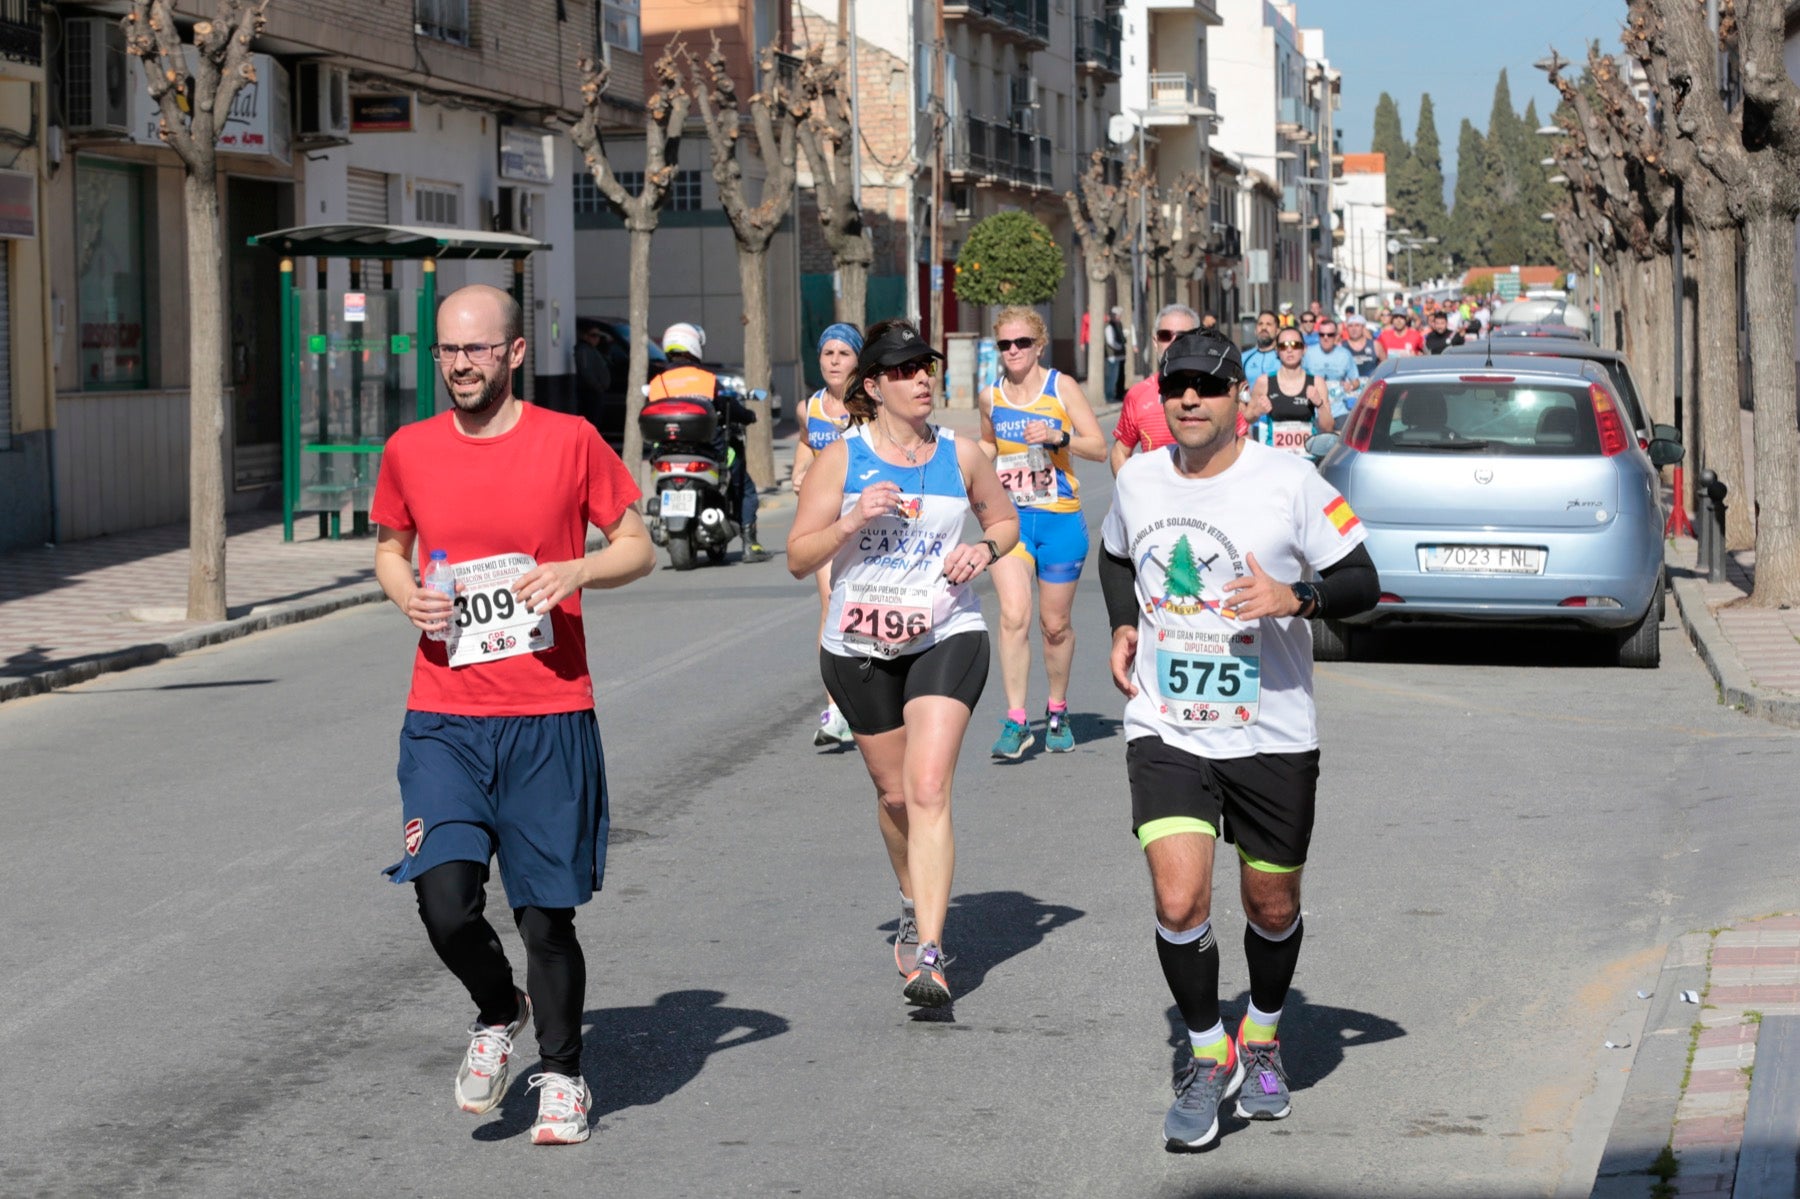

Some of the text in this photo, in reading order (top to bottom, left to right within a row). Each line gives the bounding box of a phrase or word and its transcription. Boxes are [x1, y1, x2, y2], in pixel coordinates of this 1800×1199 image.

[1001, 468, 1053, 490] 2113
[892, 529, 947, 540] ATLETISMO
[1154, 520, 1165, 530] DE
[1166, 517, 1207, 530] SOLDADOS
[1207, 525, 1239, 561] VETERANOS
[1233, 560, 1244, 570] DE
[859, 537, 942, 557] CAXAR
[472, 561, 497, 572] PREMIO
[498, 558, 507, 567] DE
[1443, 548, 1533, 567] 7023 FNL
[492, 567, 520, 577] GRANADA
[878, 585, 899, 595] PREMIO
[454, 588, 535, 628] 309
[844, 608, 926, 639] 2196
[1177, 631, 1193, 640] GRAN
[1195, 633, 1220, 643] PREMIO
[1221, 634, 1230, 643] DE
[1184, 642, 1224, 654] DIPUTACIÓN
[1169, 659, 1240, 697] 575
